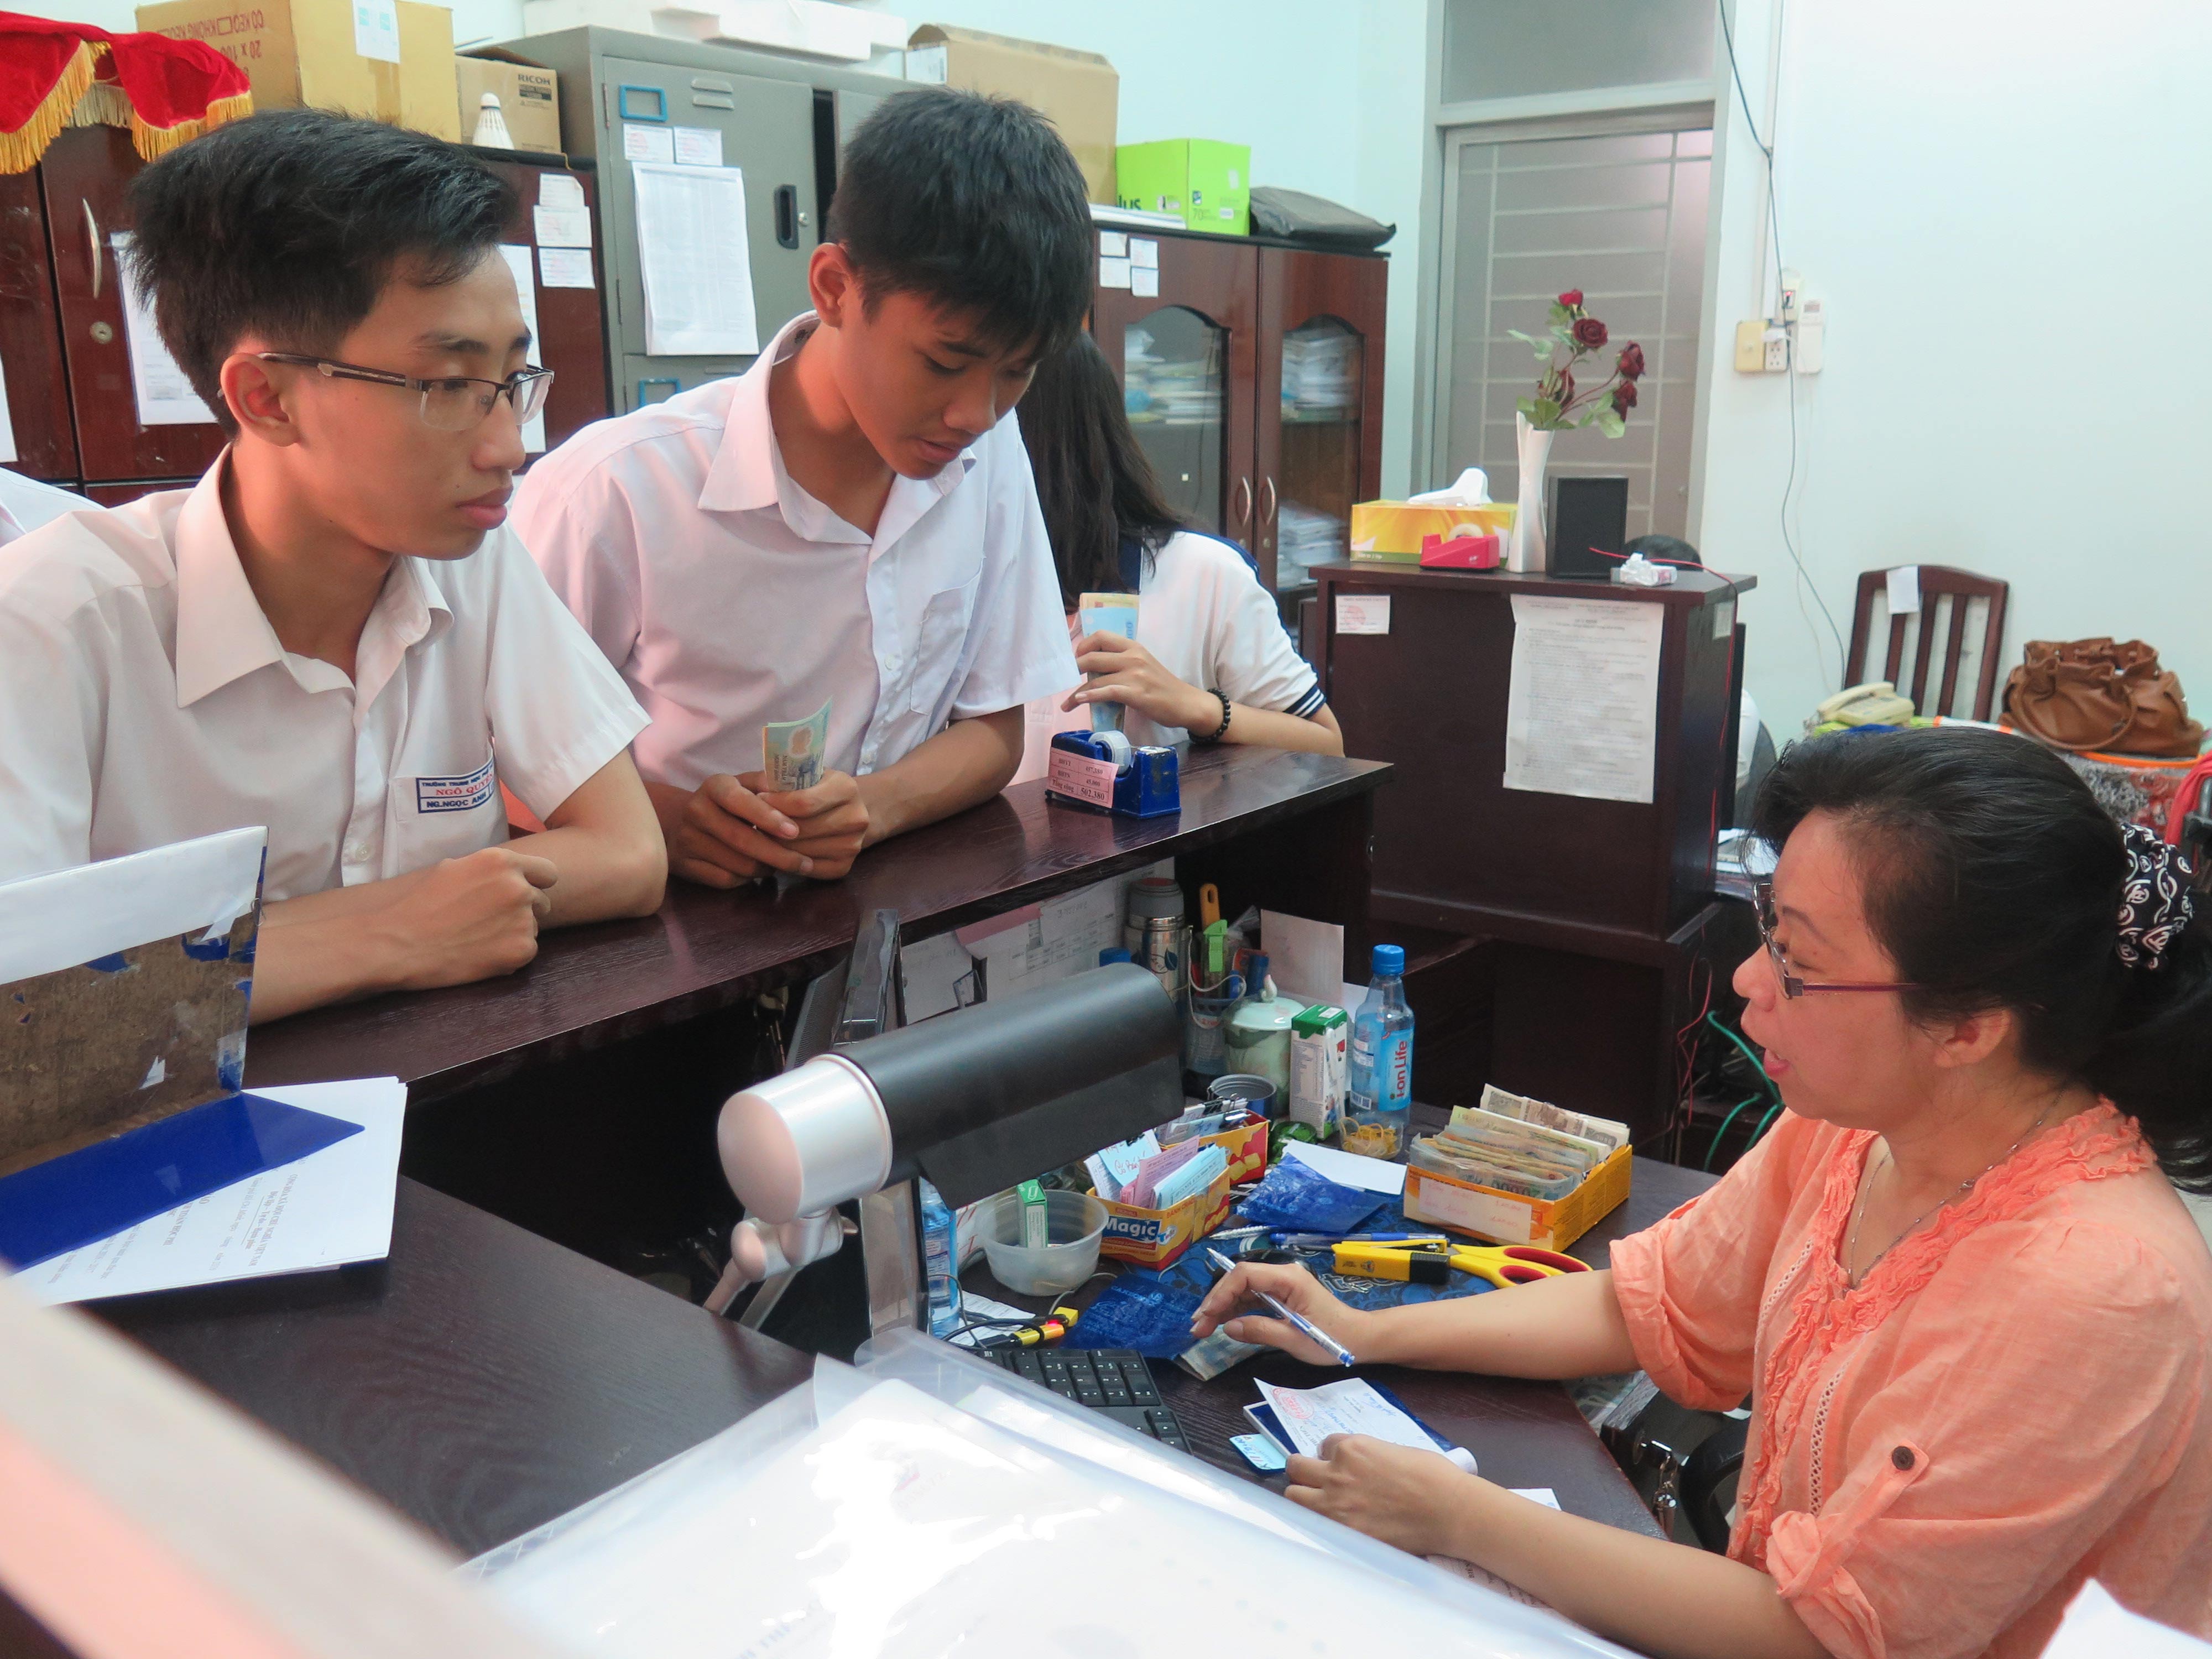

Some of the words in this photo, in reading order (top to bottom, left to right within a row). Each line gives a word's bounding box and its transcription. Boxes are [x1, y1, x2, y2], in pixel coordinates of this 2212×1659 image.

[518, 74, 551, 85] RICOH
[436, 787, 462, 796] NGÔ
[1081, 787, 1104, 800] 502.380
[472, 792, 486, 804] ANH
[1107, 1216, 1157, 1237] Magic
